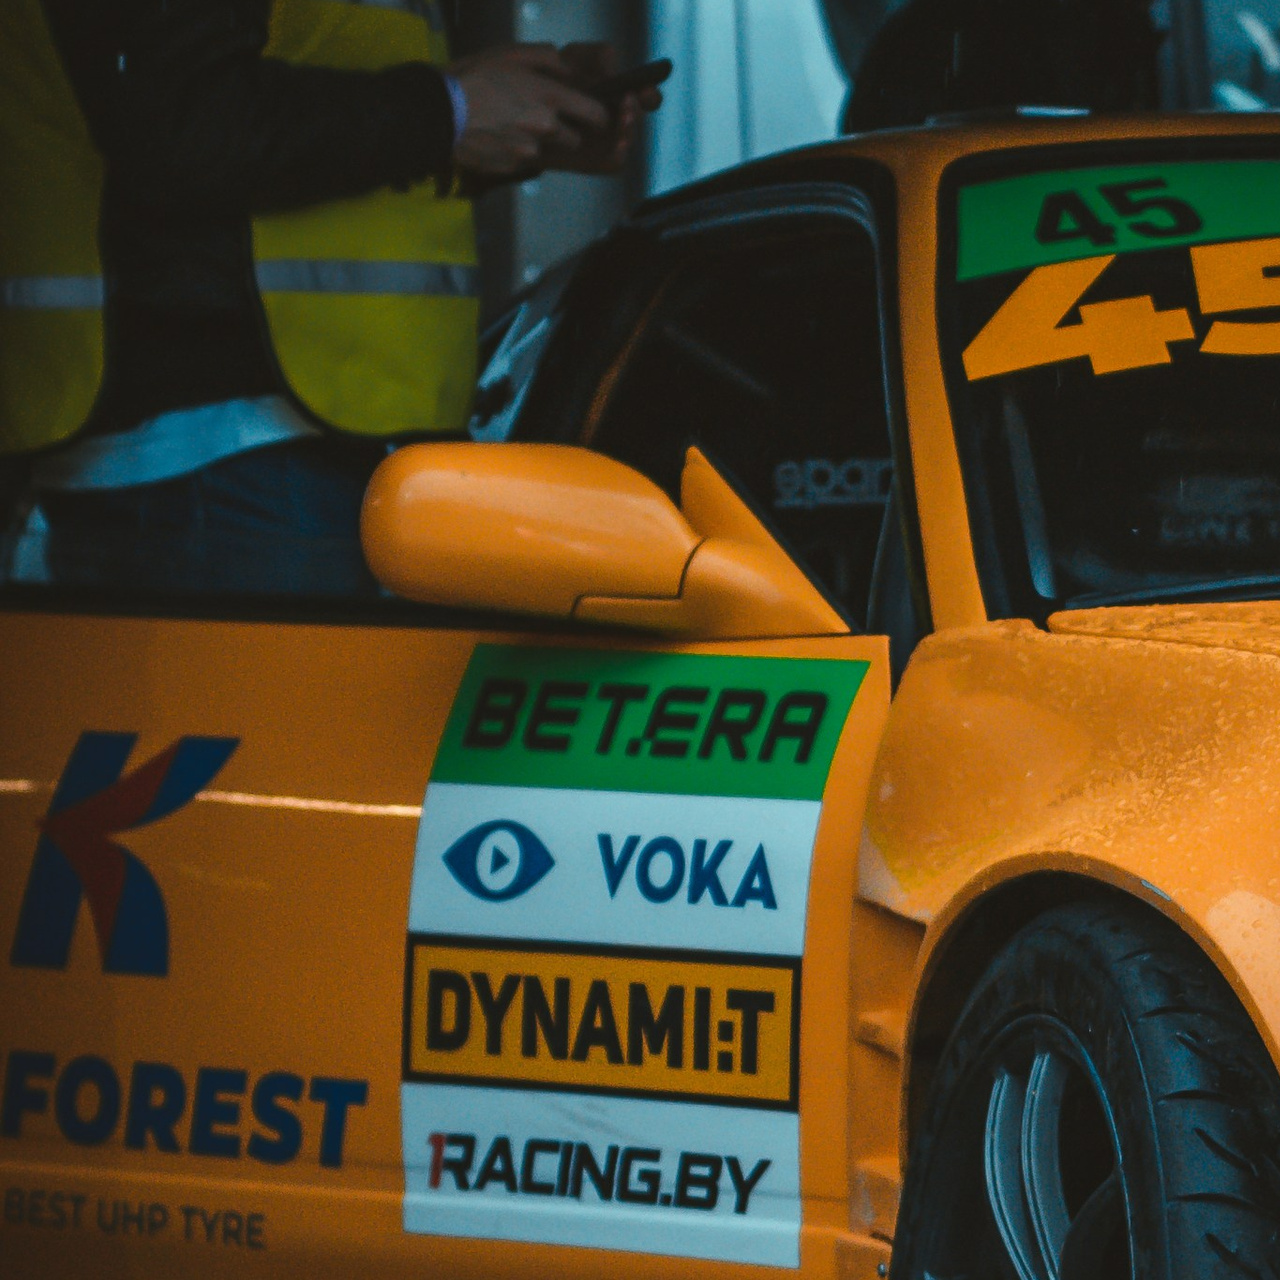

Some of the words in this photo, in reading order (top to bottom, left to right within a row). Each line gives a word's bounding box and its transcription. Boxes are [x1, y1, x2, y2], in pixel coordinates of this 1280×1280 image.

[1034, 177, 1204, 248] 45
[598, 833, 778, 910] VOKA
[0, 1049, 369, 1169] FOREST
[3, 1187, 86, 1230] BEST
[97, 1198, 170, 1235] UHP
[180, 1205, 267, 1250] TYRE
